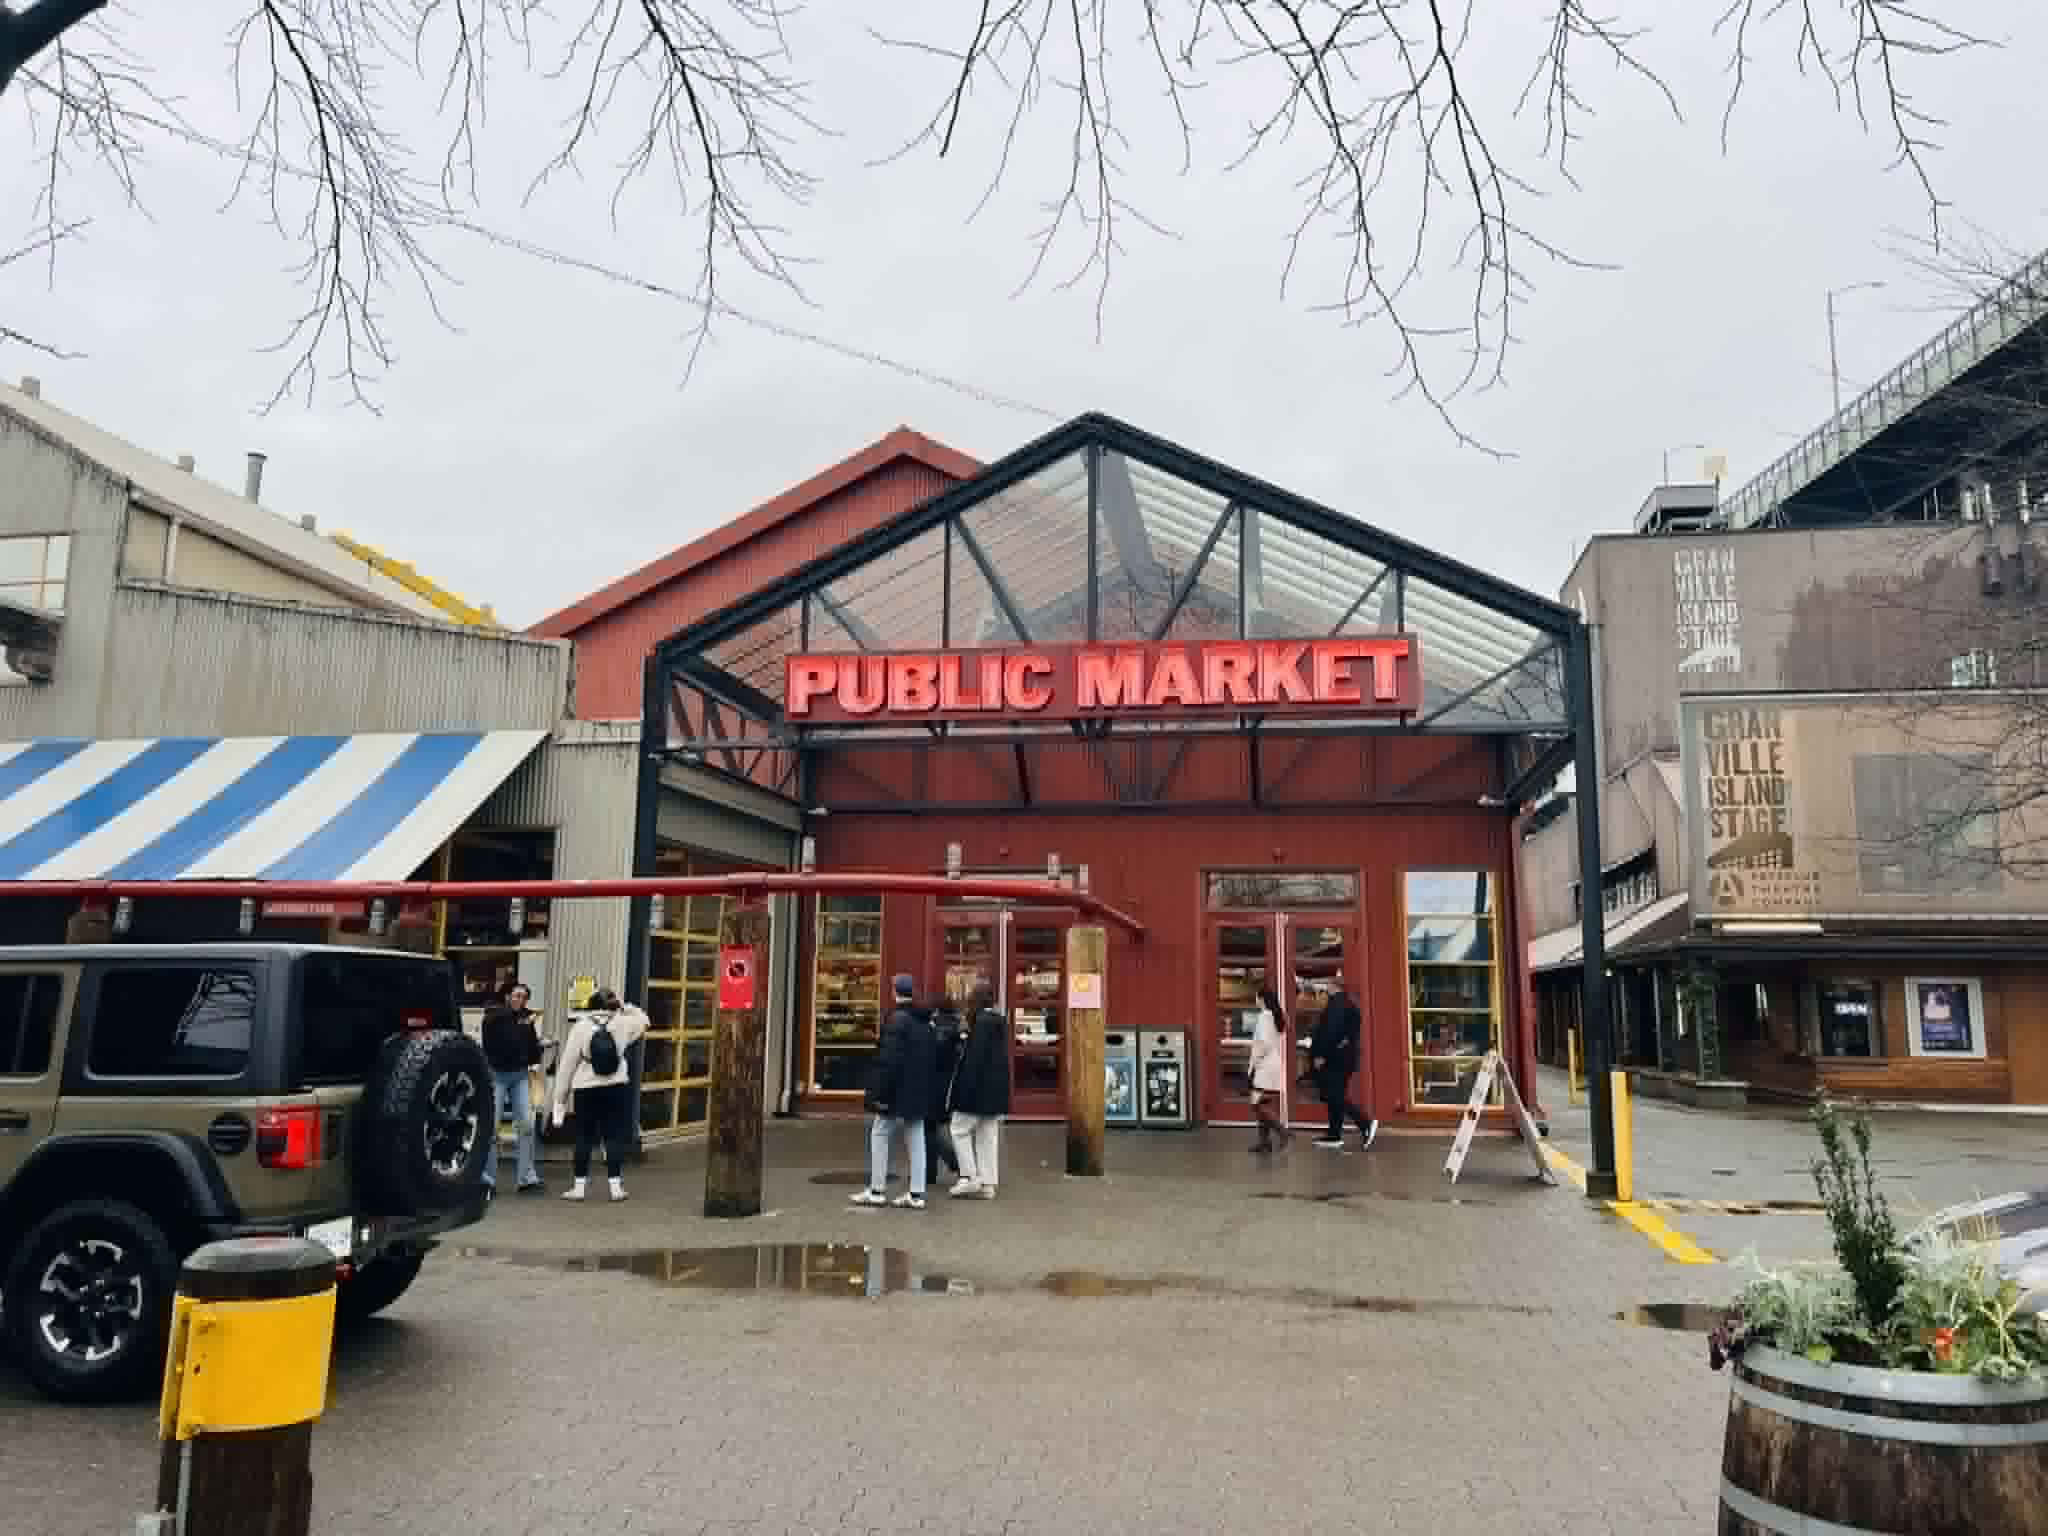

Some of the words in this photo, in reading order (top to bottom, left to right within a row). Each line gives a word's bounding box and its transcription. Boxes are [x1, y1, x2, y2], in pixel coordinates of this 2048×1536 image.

[1674, 547, 1736, 576] GRAN
[1675, 576, 1736, 600] VILLE
[1678, 600, 1738, 625] ISLAND
[1679, 624, 1738, 648] STAGE
[788, 654, 1055, 714] PUBLIC
[1076, 640, 1408, 706] MARKET
[1703, 710, 1784, 738] GRAN
[1703, 741, 1785, 775] VILLE
[1708, 776, 1785, 806] ISLAND
[1710, 807, 1787, 838] STAGE
